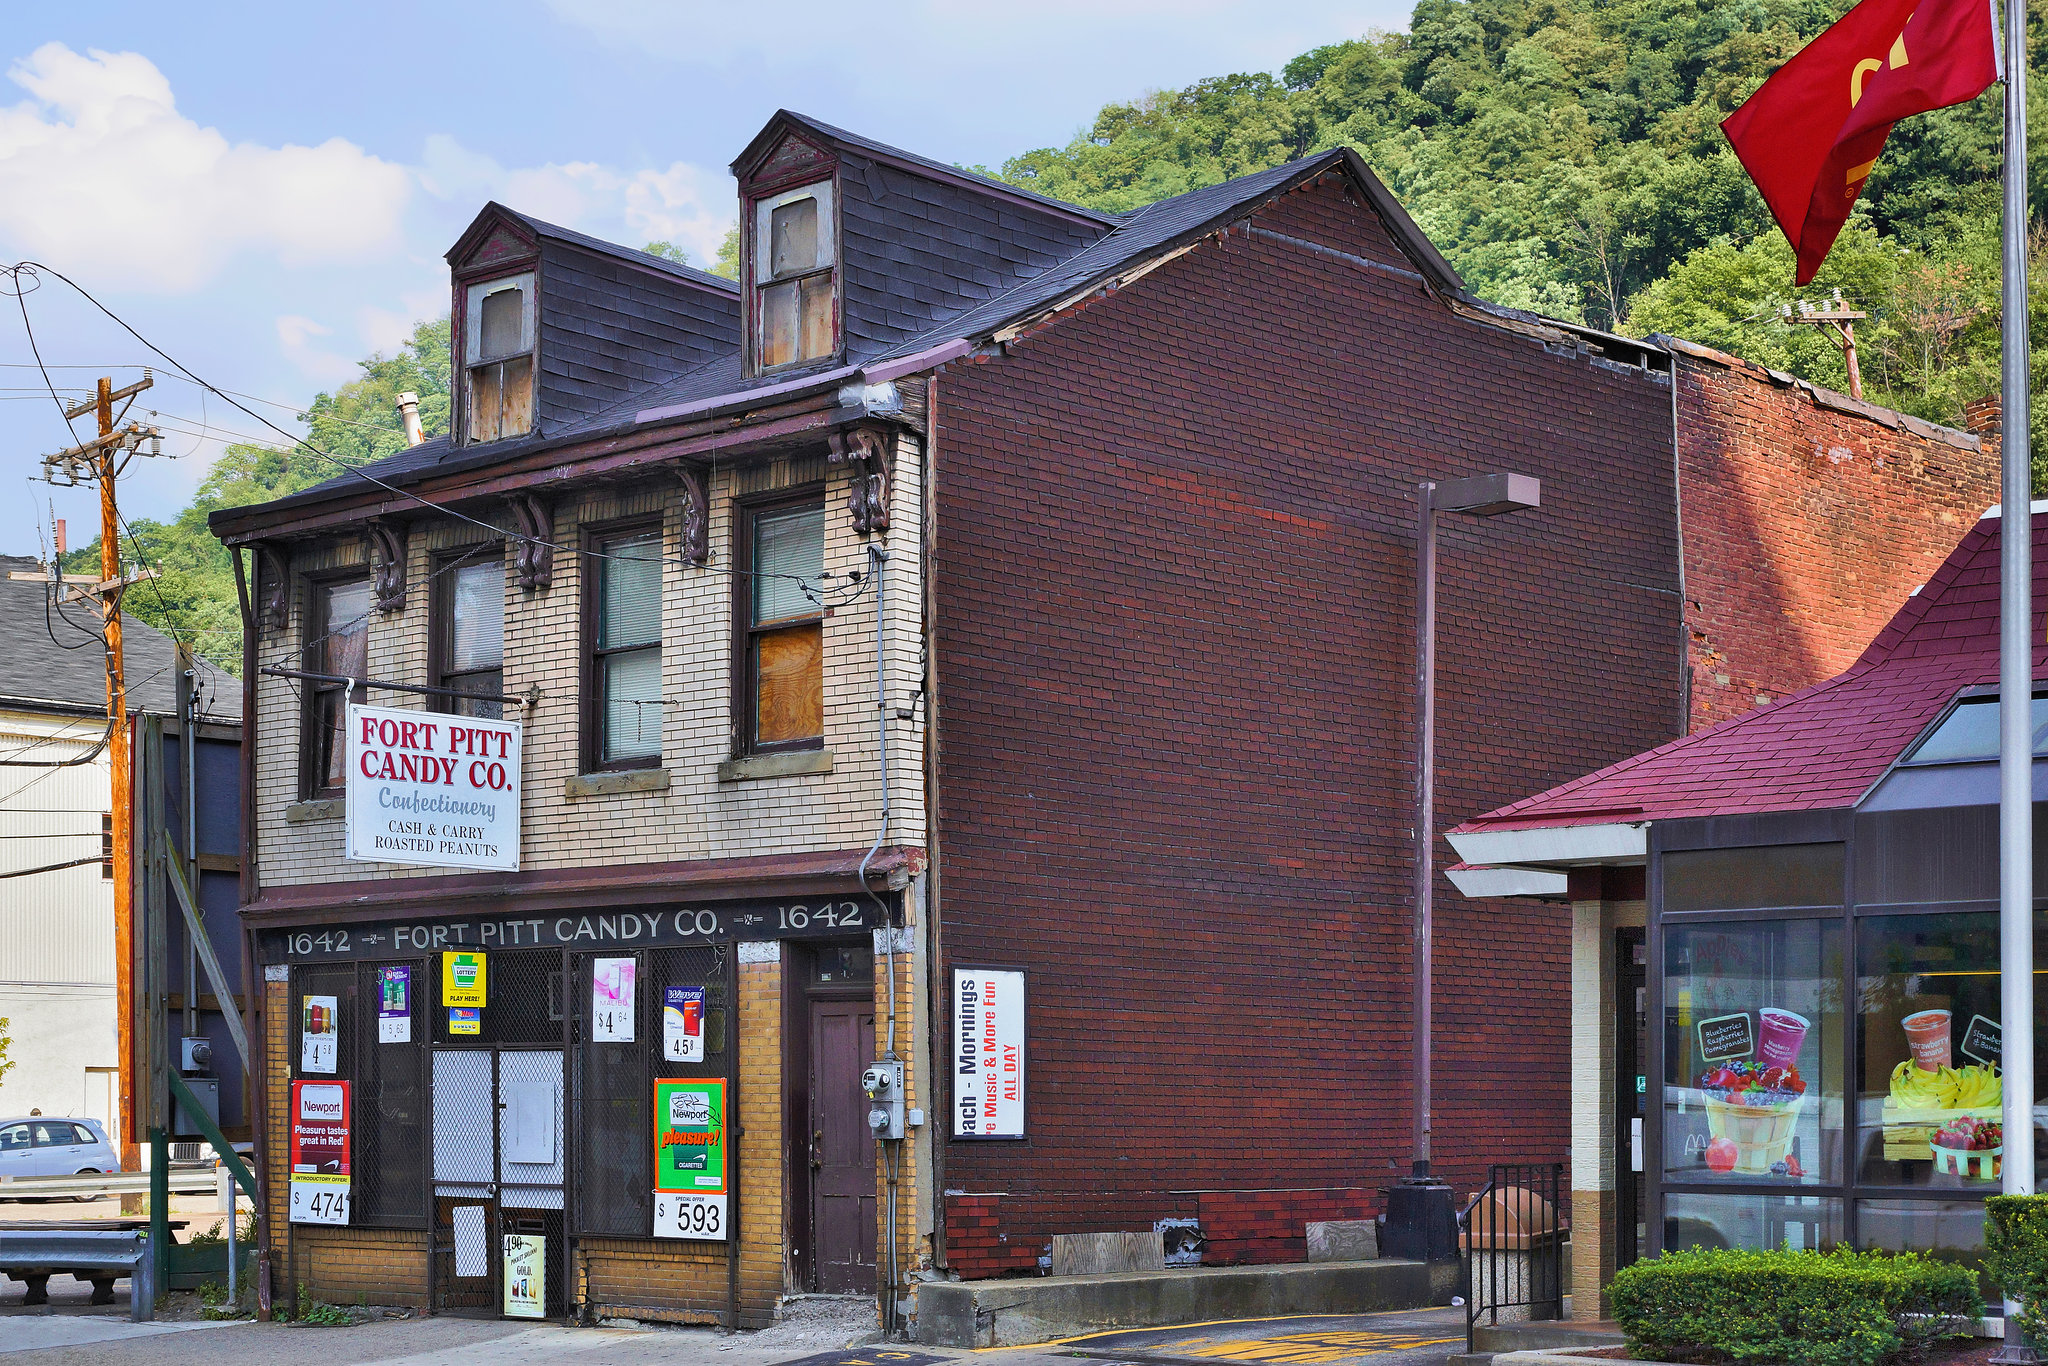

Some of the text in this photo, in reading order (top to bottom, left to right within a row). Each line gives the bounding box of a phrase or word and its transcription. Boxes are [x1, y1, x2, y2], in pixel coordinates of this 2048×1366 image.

[361, 717, 512, 758] FORT PITT
[360, 750, 512, 792] CANDY CO.
[379, 786, 496, 823] Confectionery
[388, 820, 485, 840] CASH & CARRY
[375, 836, 498, 857] ROASTED PEANUTS
[287, 902, 863, 954] 1642 FORT PITT CANDY CO. 1642
[668, 990, 702, 999] Wave
[983, 982, 996, 1006] Fun
[959, 979, 978, 1074] Mornings
[984, 1011, 996, 1052] More
[1706, 1022, 1742, 1038] Blueberries
[1704, 1037, 1750, 1054] Pomegranates
[1707, 1030, 1744, 1045] Raspberries
[1910, 1036, 1949, 1049] strawberry
[1919, 1047, 1944, 1057] banana
[984, 1057, 996, 1067] &
[1004, 1044, 1016, 1101] ALL DAY
[984, 1073, 997, 1117] Music
[304, 1101, 340, 1114] Newport
[672, 1109, 706, 1120] Newport
[960, 1096, 976, 1134] ach
[294, 1125, 348, 1135] Pleasure tastes
[660, 1128, 720, 1148] pleasure!
[300, 1136, 344, 1146] great in Red!
[294, 1192, 300, 1205] $
[658, 1203, 664, 1218] $
